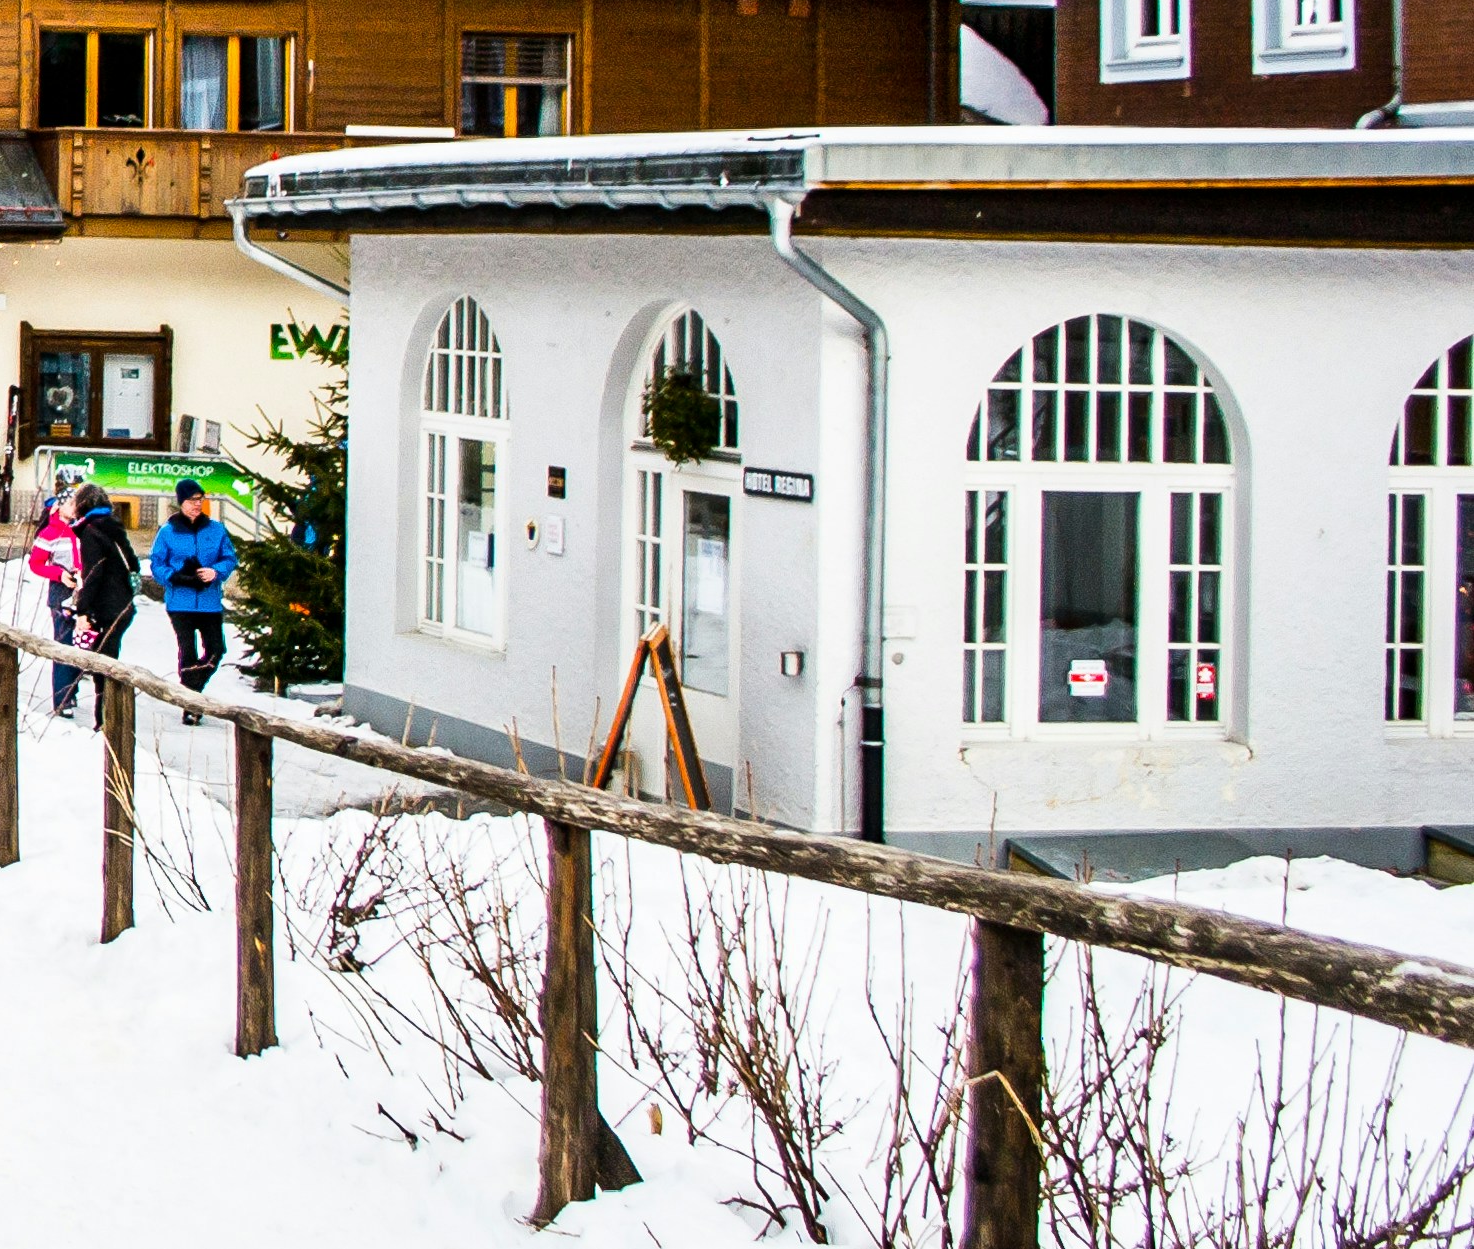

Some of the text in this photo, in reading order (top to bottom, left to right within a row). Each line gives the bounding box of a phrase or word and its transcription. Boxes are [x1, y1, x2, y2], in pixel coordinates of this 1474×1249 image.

[127, 461, 215, 478] ELEKTROSHOP
[744, 472, 810, 498] HOTEL REGINA
